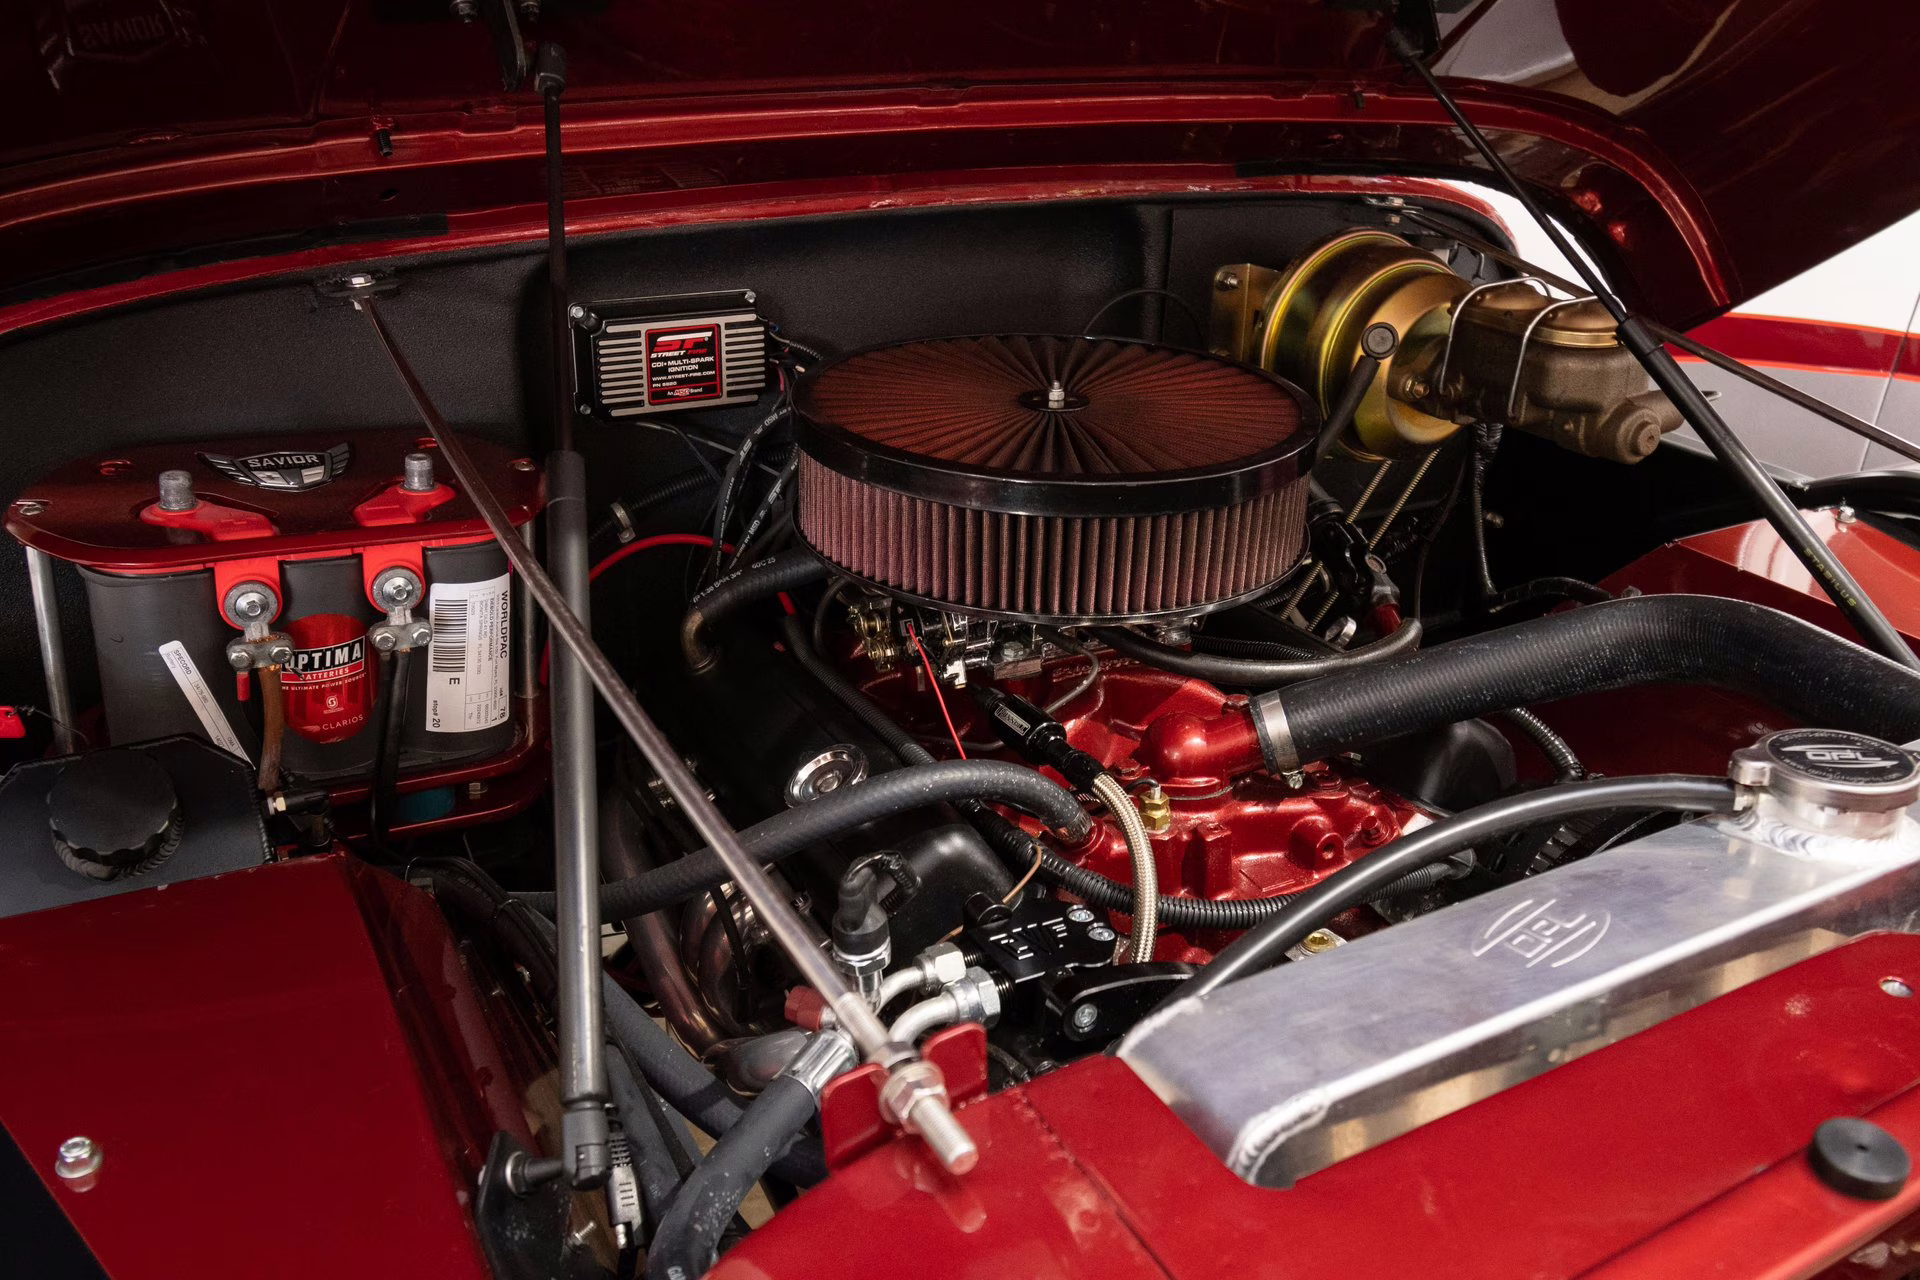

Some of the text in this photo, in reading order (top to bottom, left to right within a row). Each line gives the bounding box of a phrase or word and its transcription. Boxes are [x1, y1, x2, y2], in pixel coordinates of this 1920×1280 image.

[650, 350, 687, 359] STREET
[667, 355, 715, 367] MULTI-SPARK
[667, 364, 699, 373] IGNITION
[247, 454, 320, 468] SAVIOR
[1803, 547, 1857, 607] STABILUS
[500, 590, 508, 659] WORLDPAC
[173, 649, 193, 676] SPECORD
[301, 666, 350, 681] ATTERIES
[321, 680, 343, 689] POWER
[449, 677, 460, 685] E
[322, 713, 364, 730] CLARIOS
[432, 718, 441, 728] 20
